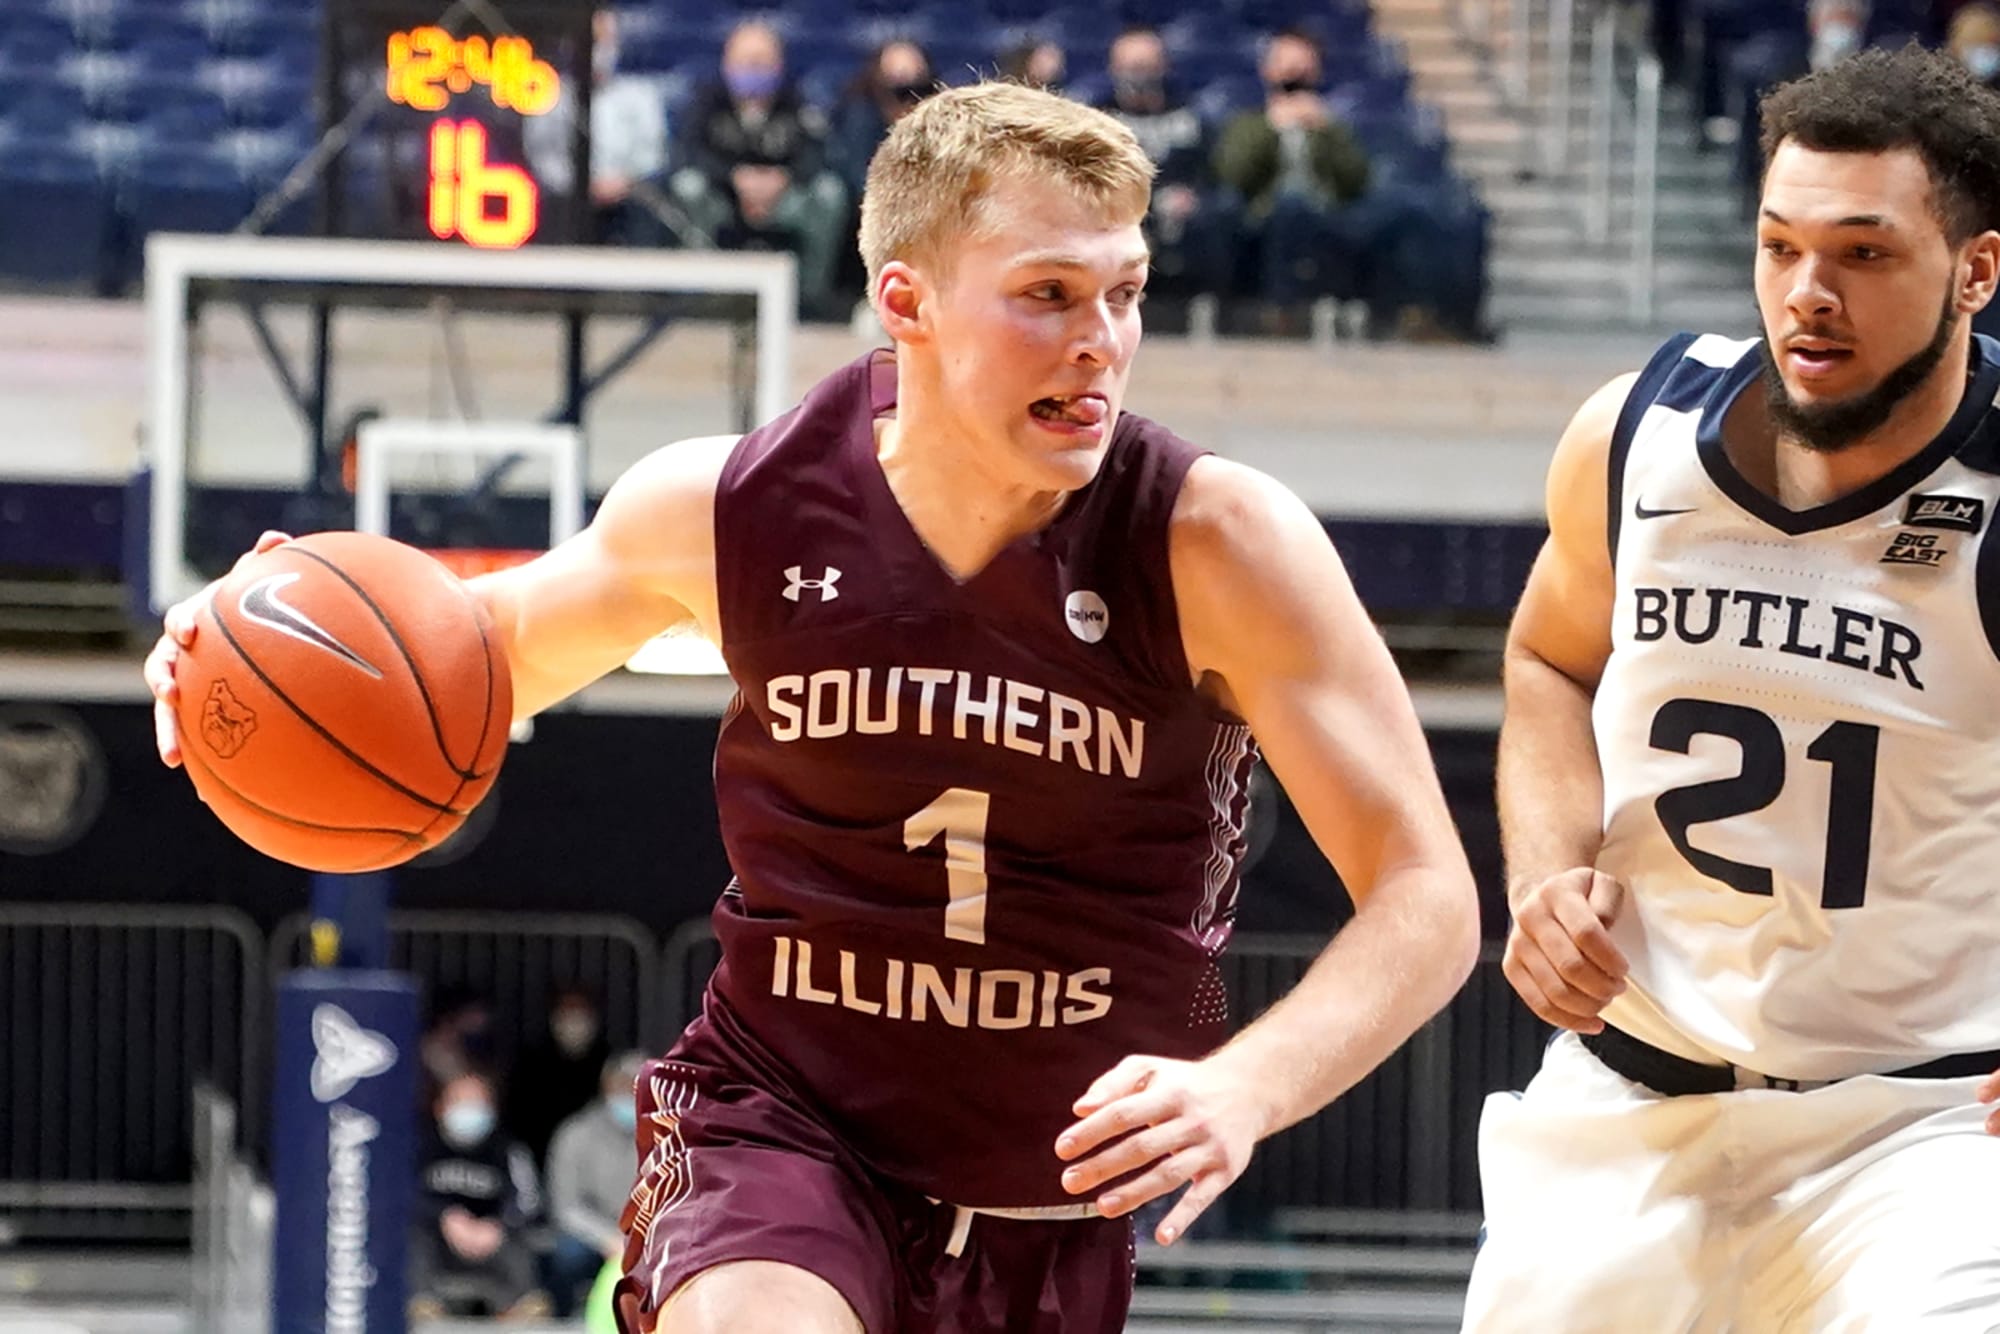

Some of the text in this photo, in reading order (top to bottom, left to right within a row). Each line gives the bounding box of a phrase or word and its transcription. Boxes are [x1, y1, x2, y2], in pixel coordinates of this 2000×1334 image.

[387, 26, 561, 116] 12:46
[429, 117, 539, 249] 16
[1884, 546, 1948, 561] EAST
[1893, 532, 1939, 548] BIG
[1915, 500, 1977, 519] BLM
[1634, 587, 1925, 691] BUTLER
[766, 666, 1145, 778] SOUTHERN
[1649, 698, 1881, 910] 21
[903, 787, 990, 945] 1
[772, 936, 1113, 1030] ILLINOIS
